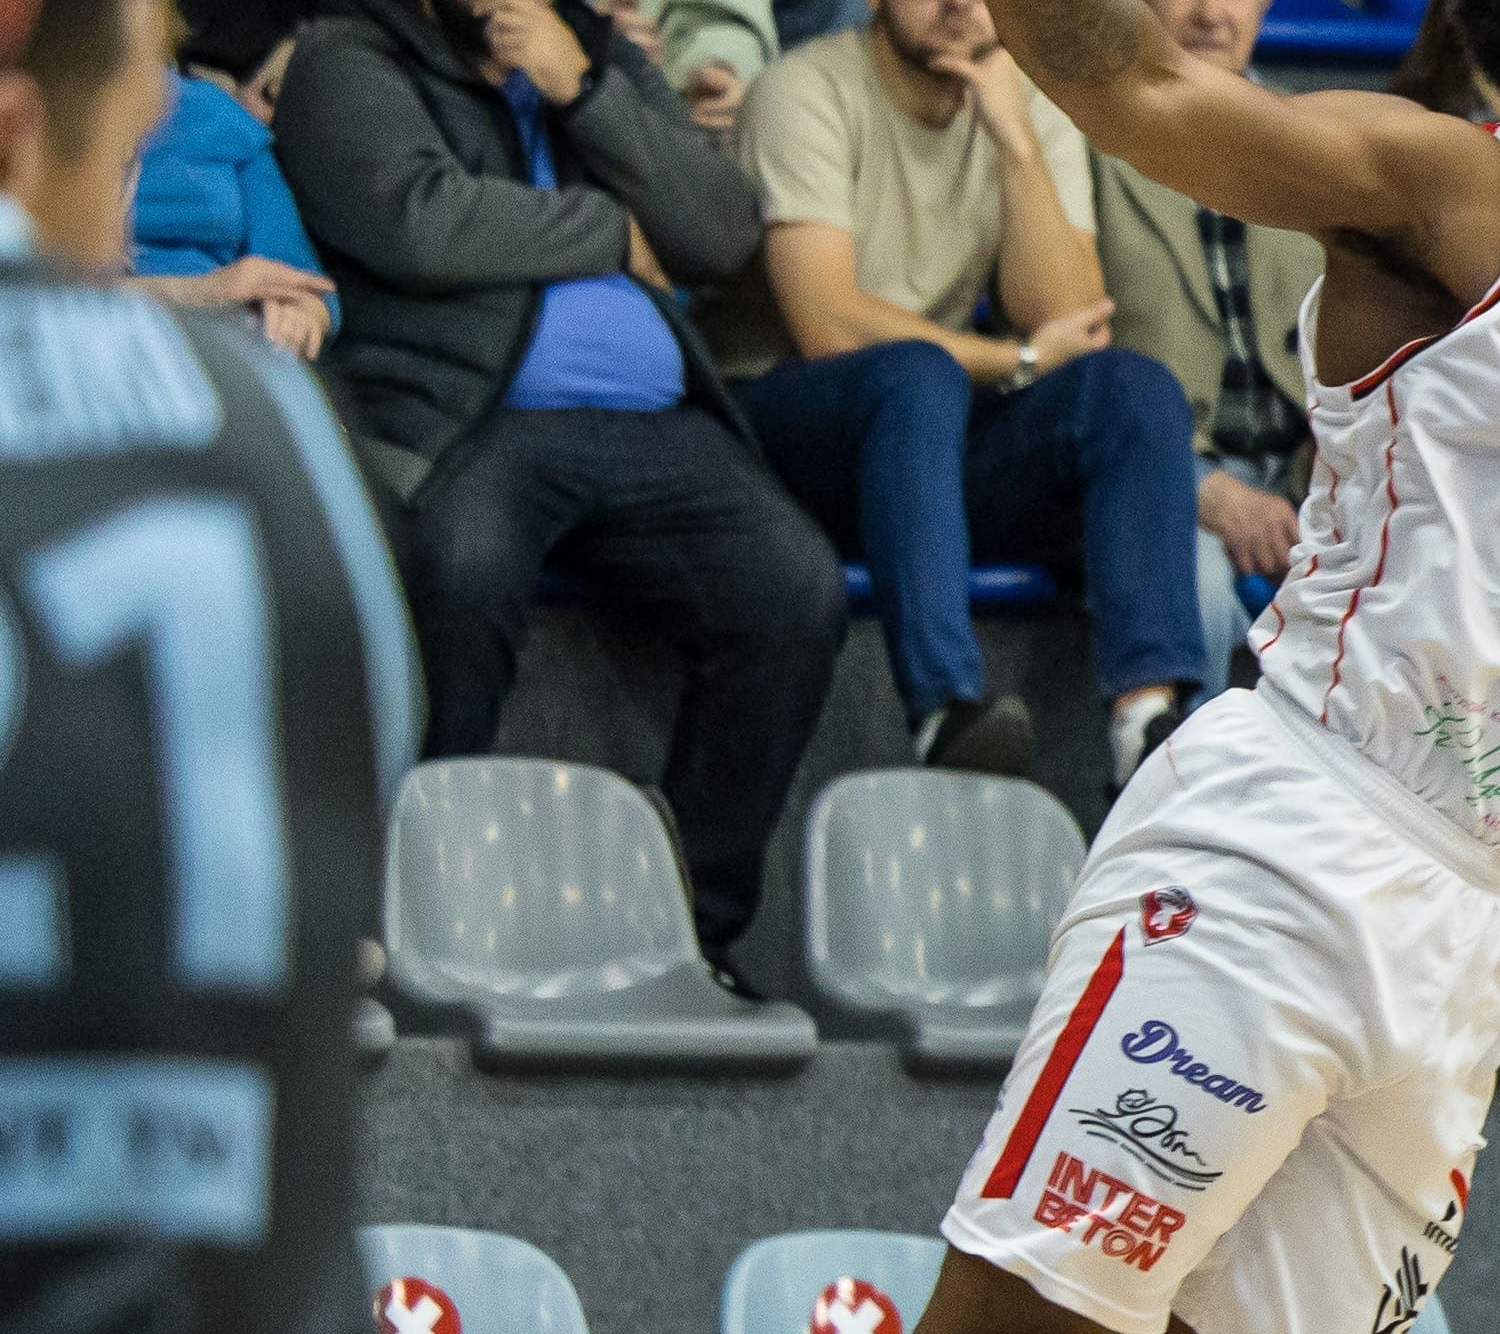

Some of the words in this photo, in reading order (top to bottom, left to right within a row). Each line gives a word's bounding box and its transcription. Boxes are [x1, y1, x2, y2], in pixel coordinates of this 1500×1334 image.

[1121, 1019, 1268, 1114] Dream
[1033, 1188, 1169, 1272] BETON
[1048, 1150, 1187, 1243] INTER
